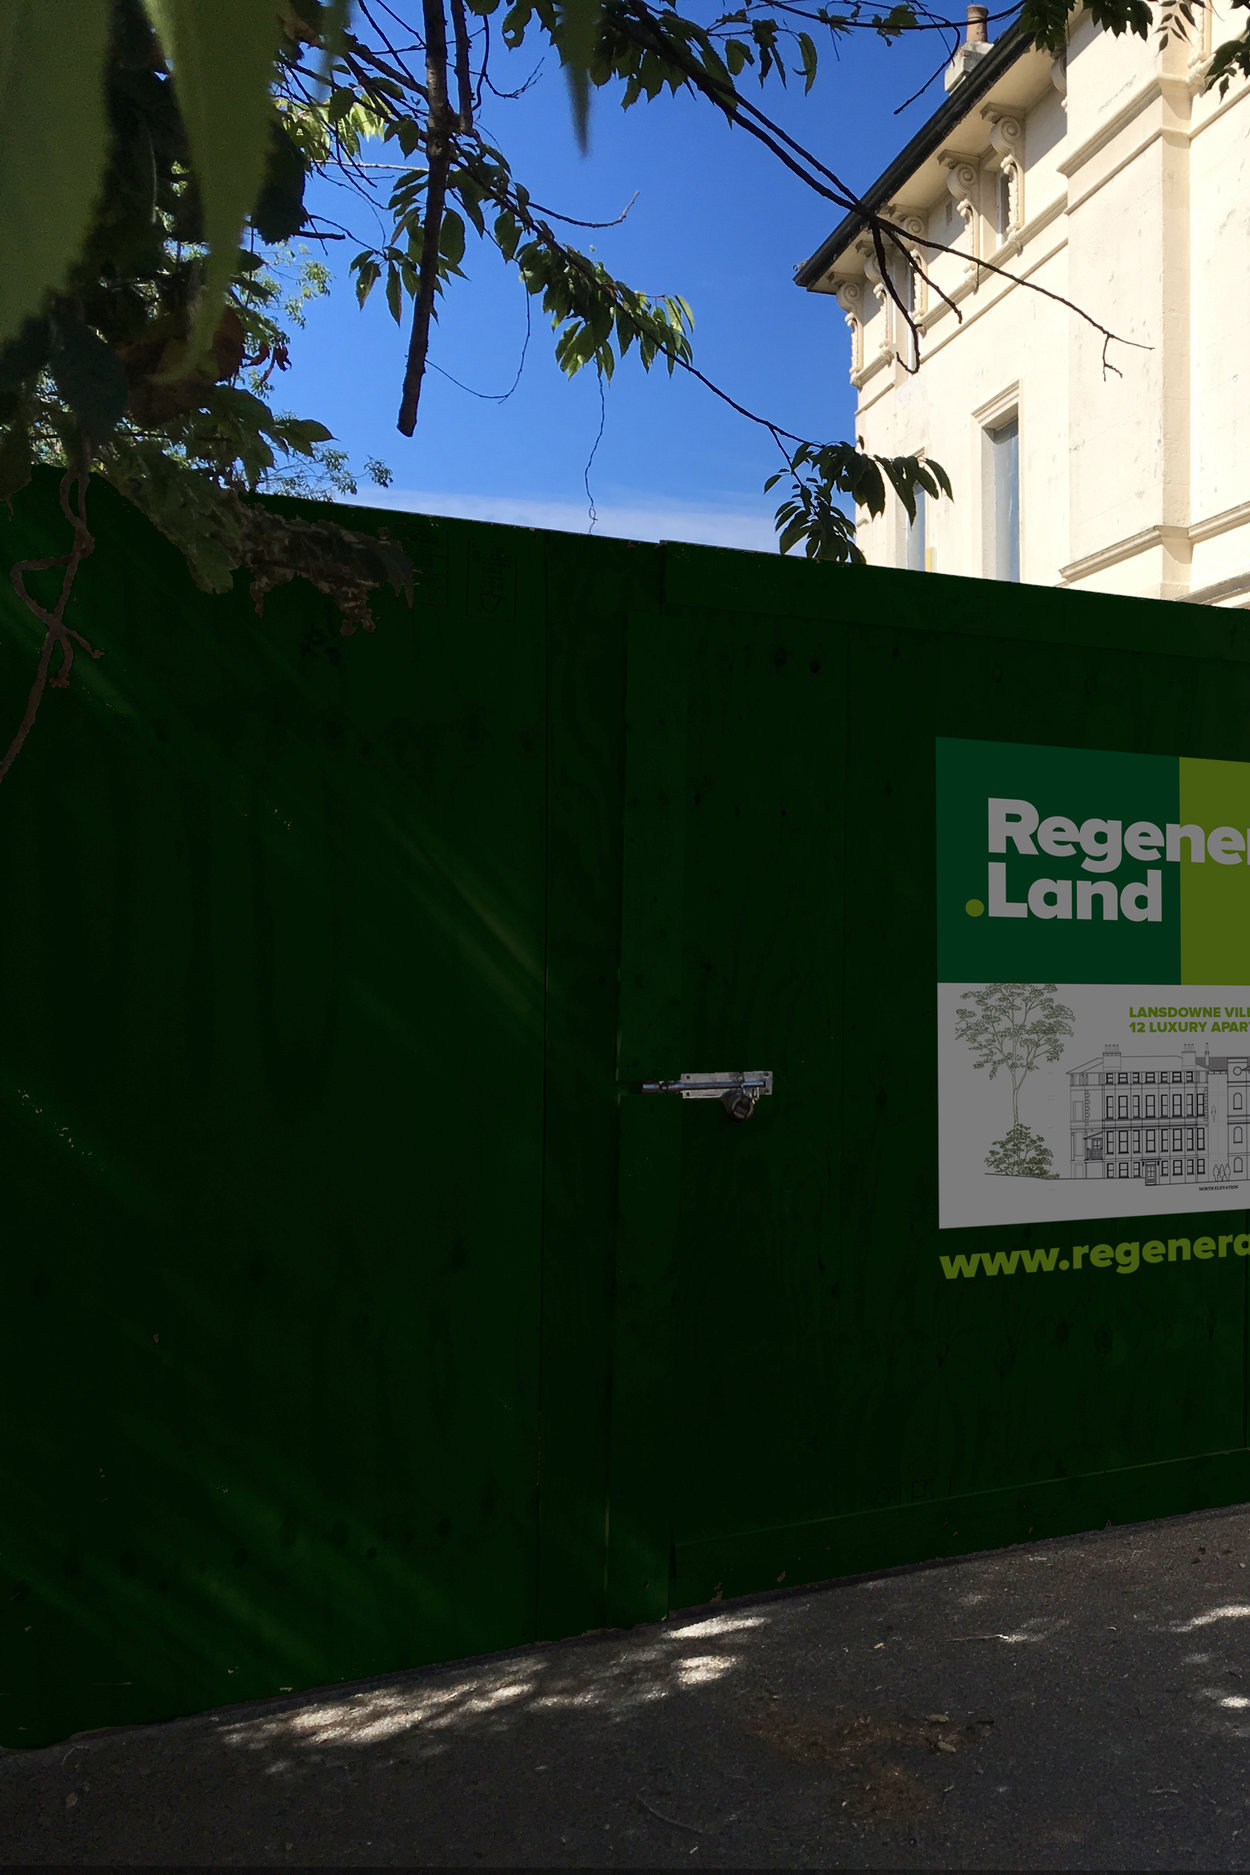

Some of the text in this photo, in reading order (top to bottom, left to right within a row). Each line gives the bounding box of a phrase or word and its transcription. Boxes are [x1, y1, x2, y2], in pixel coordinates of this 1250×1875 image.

[1129, 1006, 1222, 1018] LANSDOWNE
[1129, 1022, 1146, 1033] 12
[1149, 1021, 1208, 1033] LUXURY
